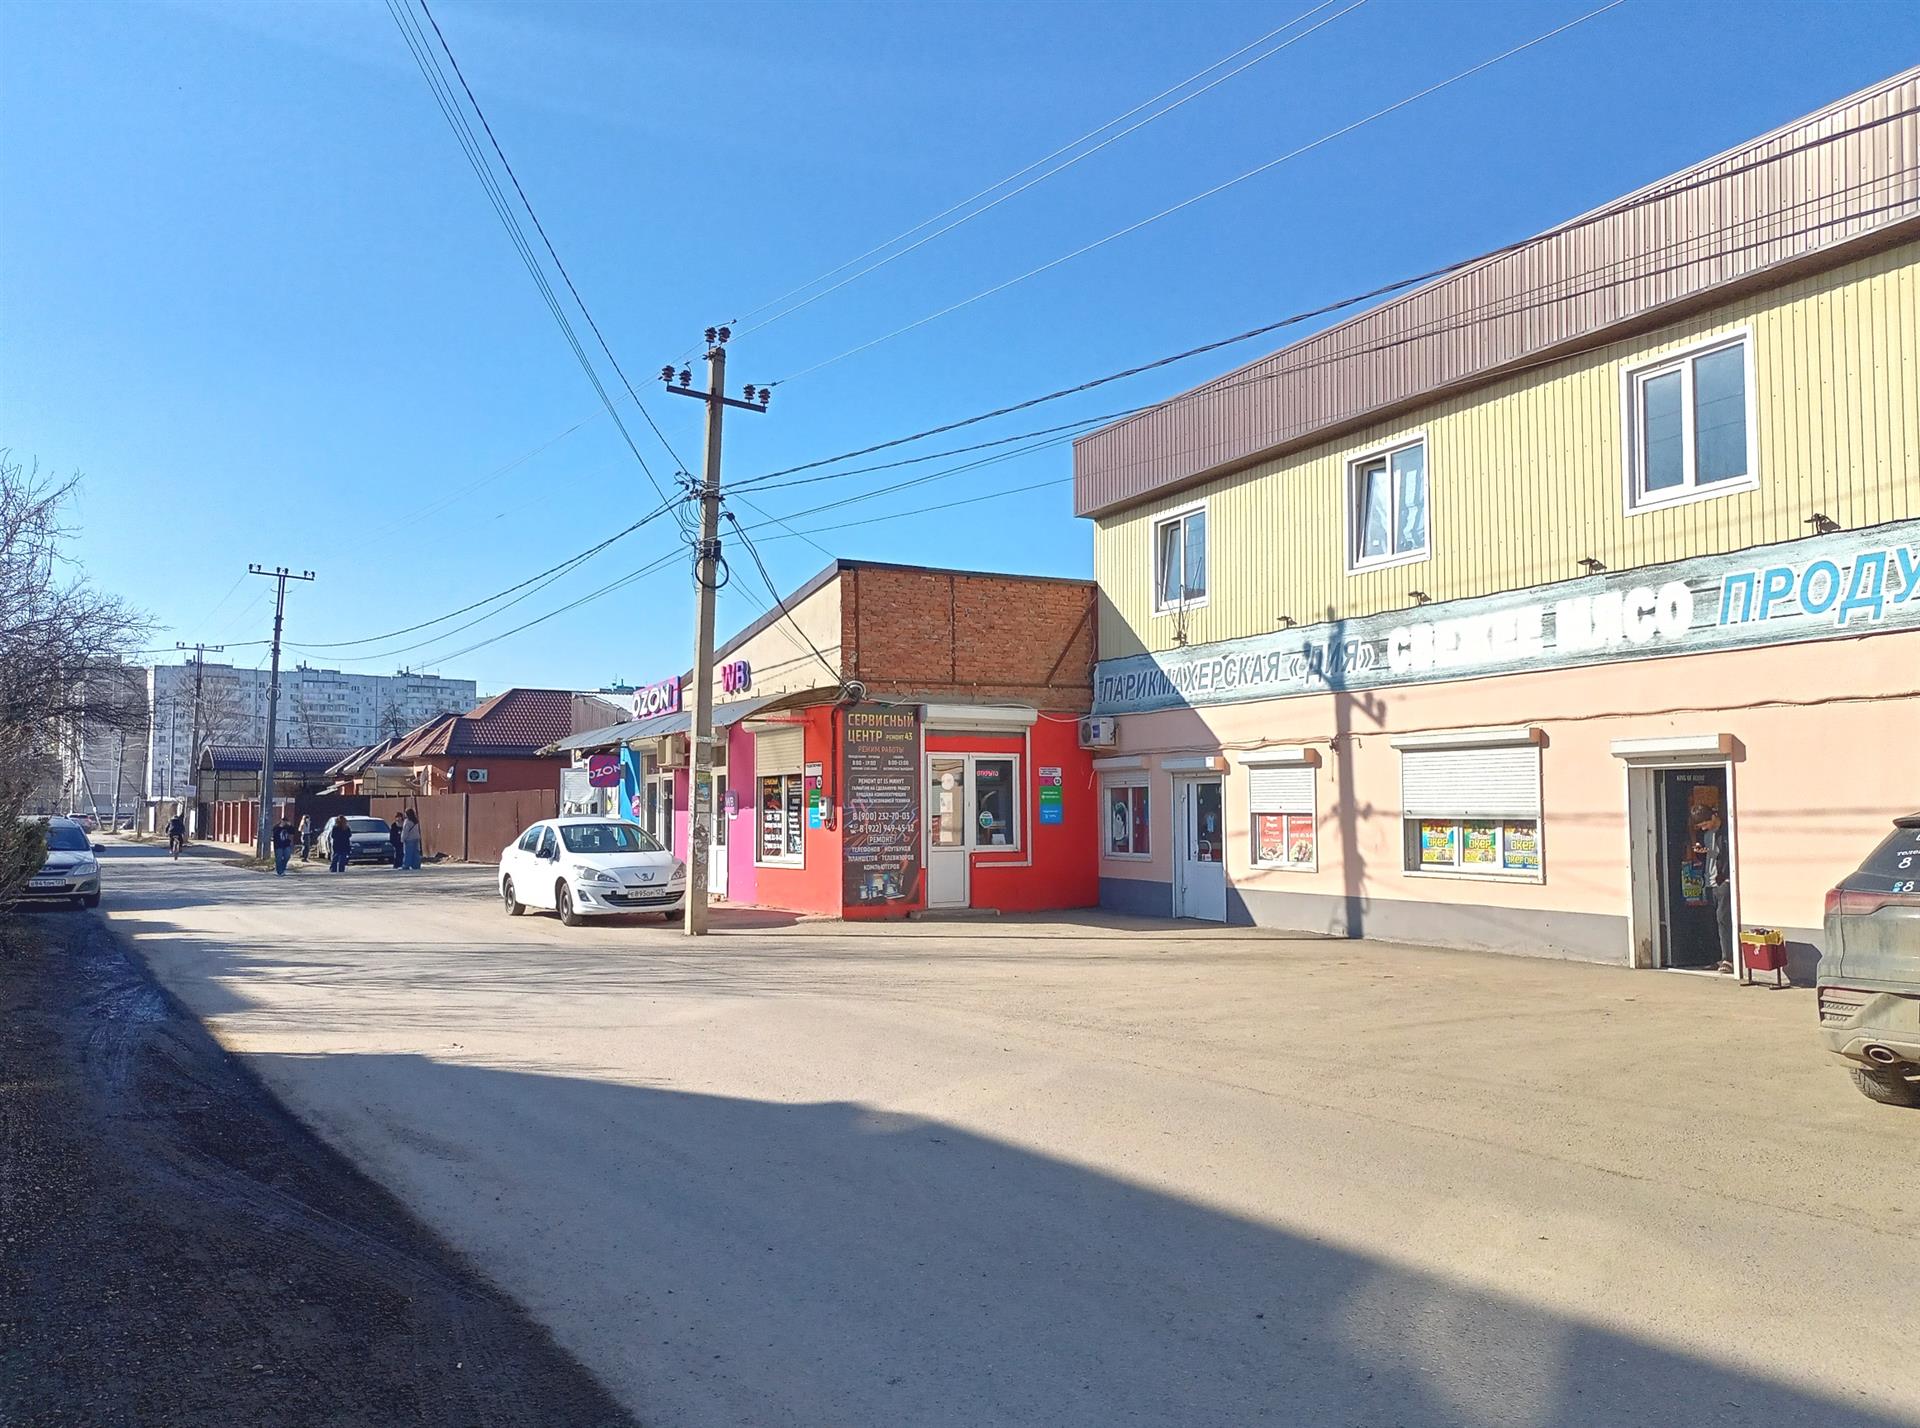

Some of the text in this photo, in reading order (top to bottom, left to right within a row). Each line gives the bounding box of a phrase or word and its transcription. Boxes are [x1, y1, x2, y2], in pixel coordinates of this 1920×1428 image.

[722, 660, 749, 693] WB
[1101, 639, 1374, 702] ПАРИКМАХЕРСКАЯ «ДИЯ»
[632, 683, 671, 718] OZON
[847, 712, 914, 728] СЕРВИСНЫЙ
[847, 729, 883, 744] ЦЕНТР
[904, 732, 913, 741] 43
[881, 746, 905, 754] РАБОТЫ
[590, 765, 621, 780] OZON
[852, 811, 858, 820] 8
[858, 811, 877, 821] (900)
[859, 824, 864, 833] 8
[869, 836, 893, 844] РЕМОНТ
[1898, 856, 1912, 869] 8
[1902, 880, 1915, 892] 8
